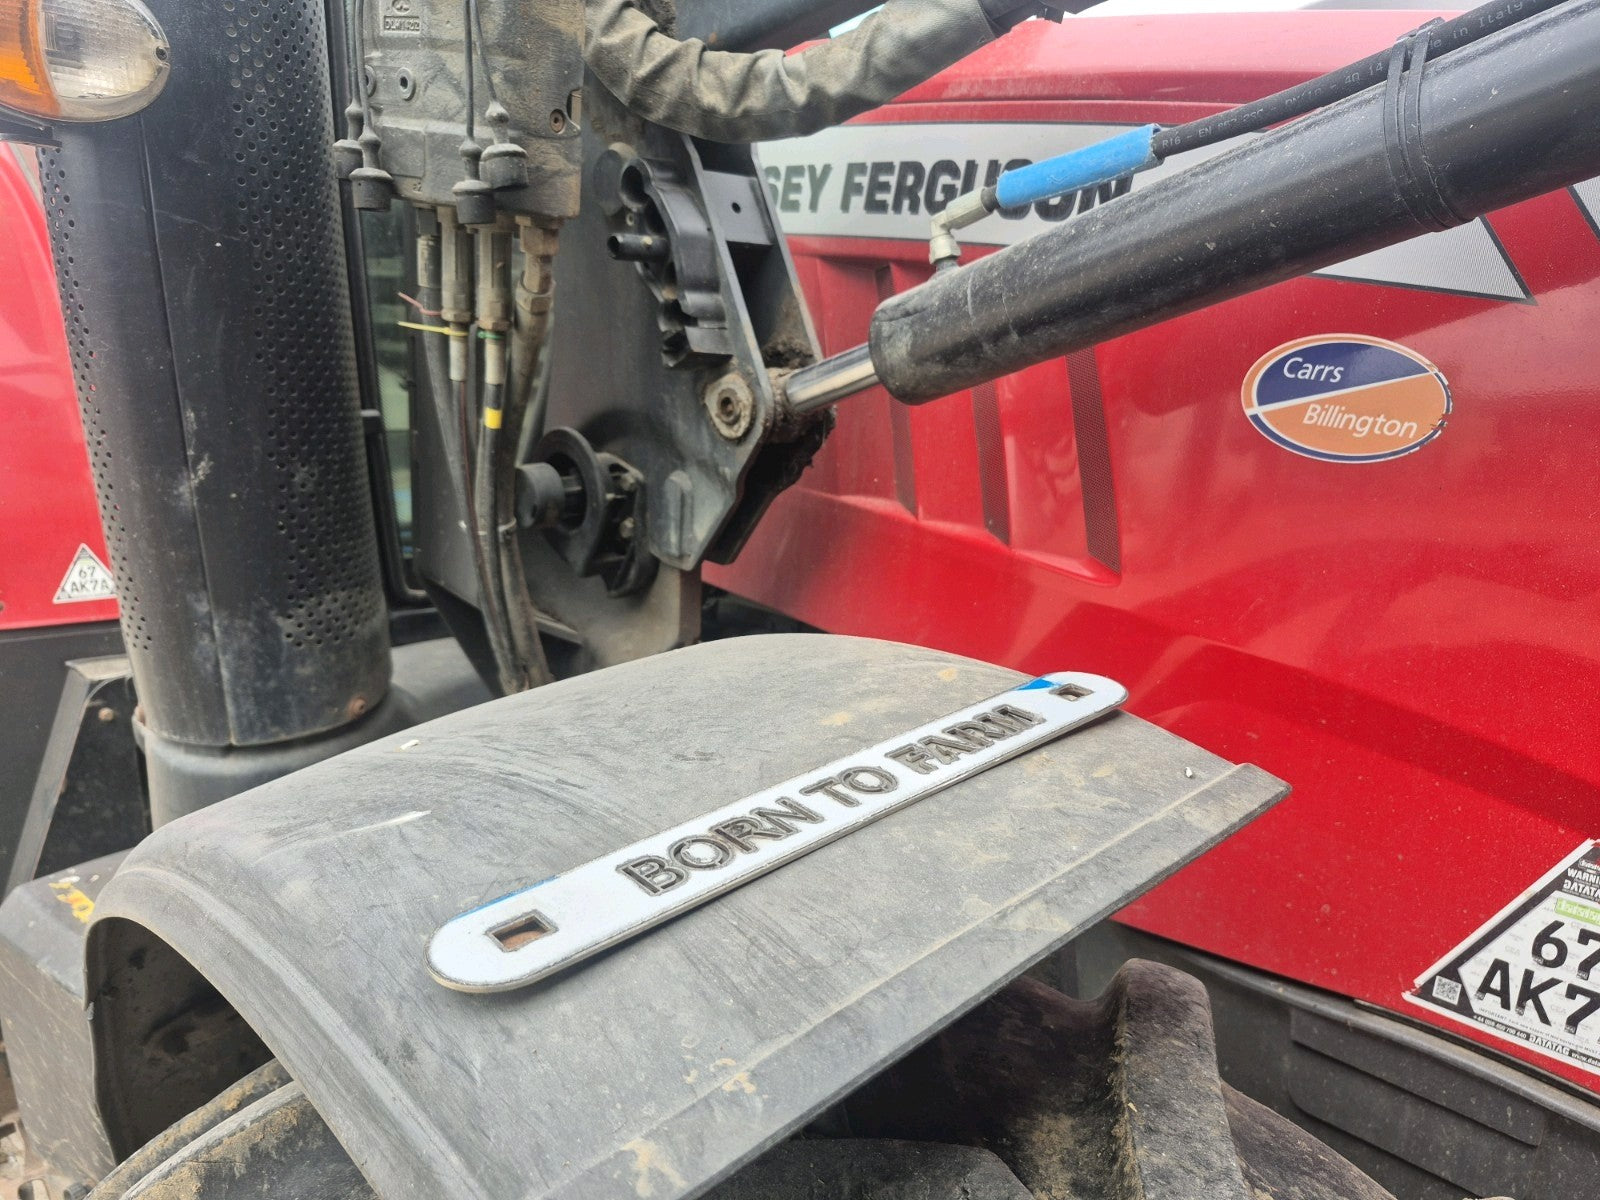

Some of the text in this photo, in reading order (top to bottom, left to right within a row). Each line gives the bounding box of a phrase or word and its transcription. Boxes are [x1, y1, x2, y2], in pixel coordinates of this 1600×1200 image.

[1452, 27, 1468, 39] in
[1283, 357, 1345, 384] Carrs
[1303, 403, 1418, 439] Billington
[616, 704, 1046, 896] BORN TO FARM
